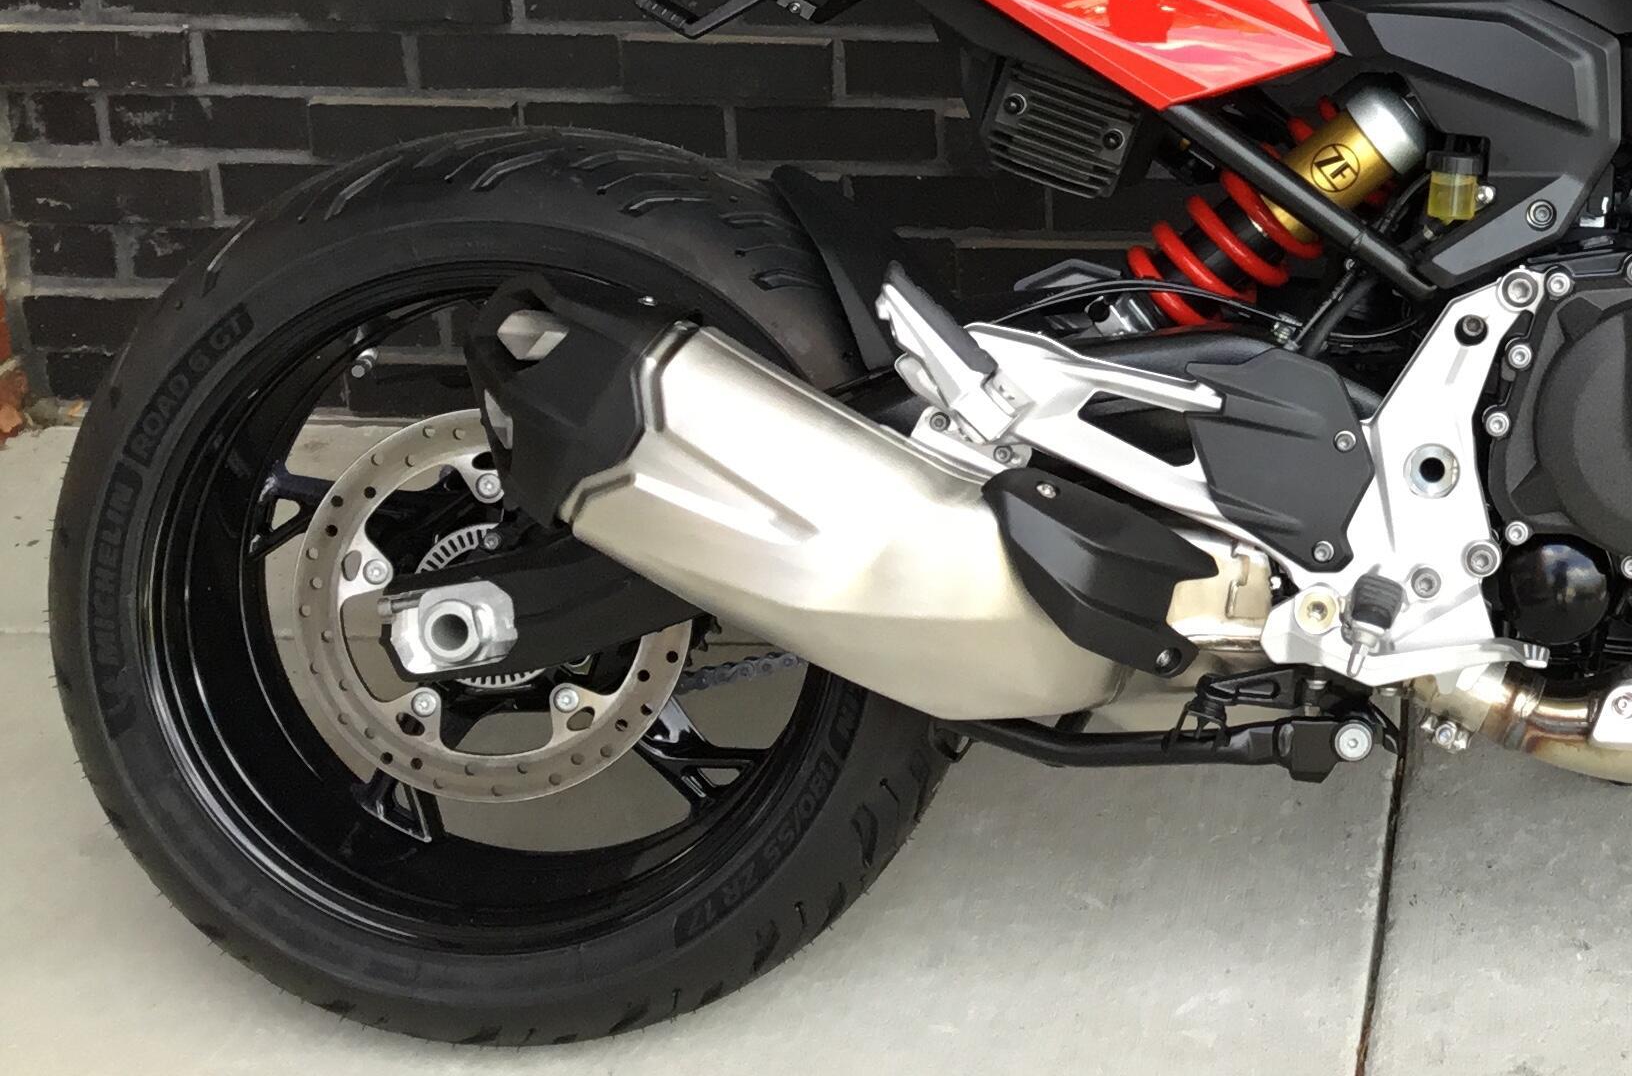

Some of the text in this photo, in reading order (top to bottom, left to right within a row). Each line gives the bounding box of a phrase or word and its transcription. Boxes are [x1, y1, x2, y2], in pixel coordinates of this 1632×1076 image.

[1312, 144, 1359, 192] ZF
[94, 480, 135, 667] MICHELIN
[131, 372, 189, 460] ROAD
[207, 314, 243, 350] GT
